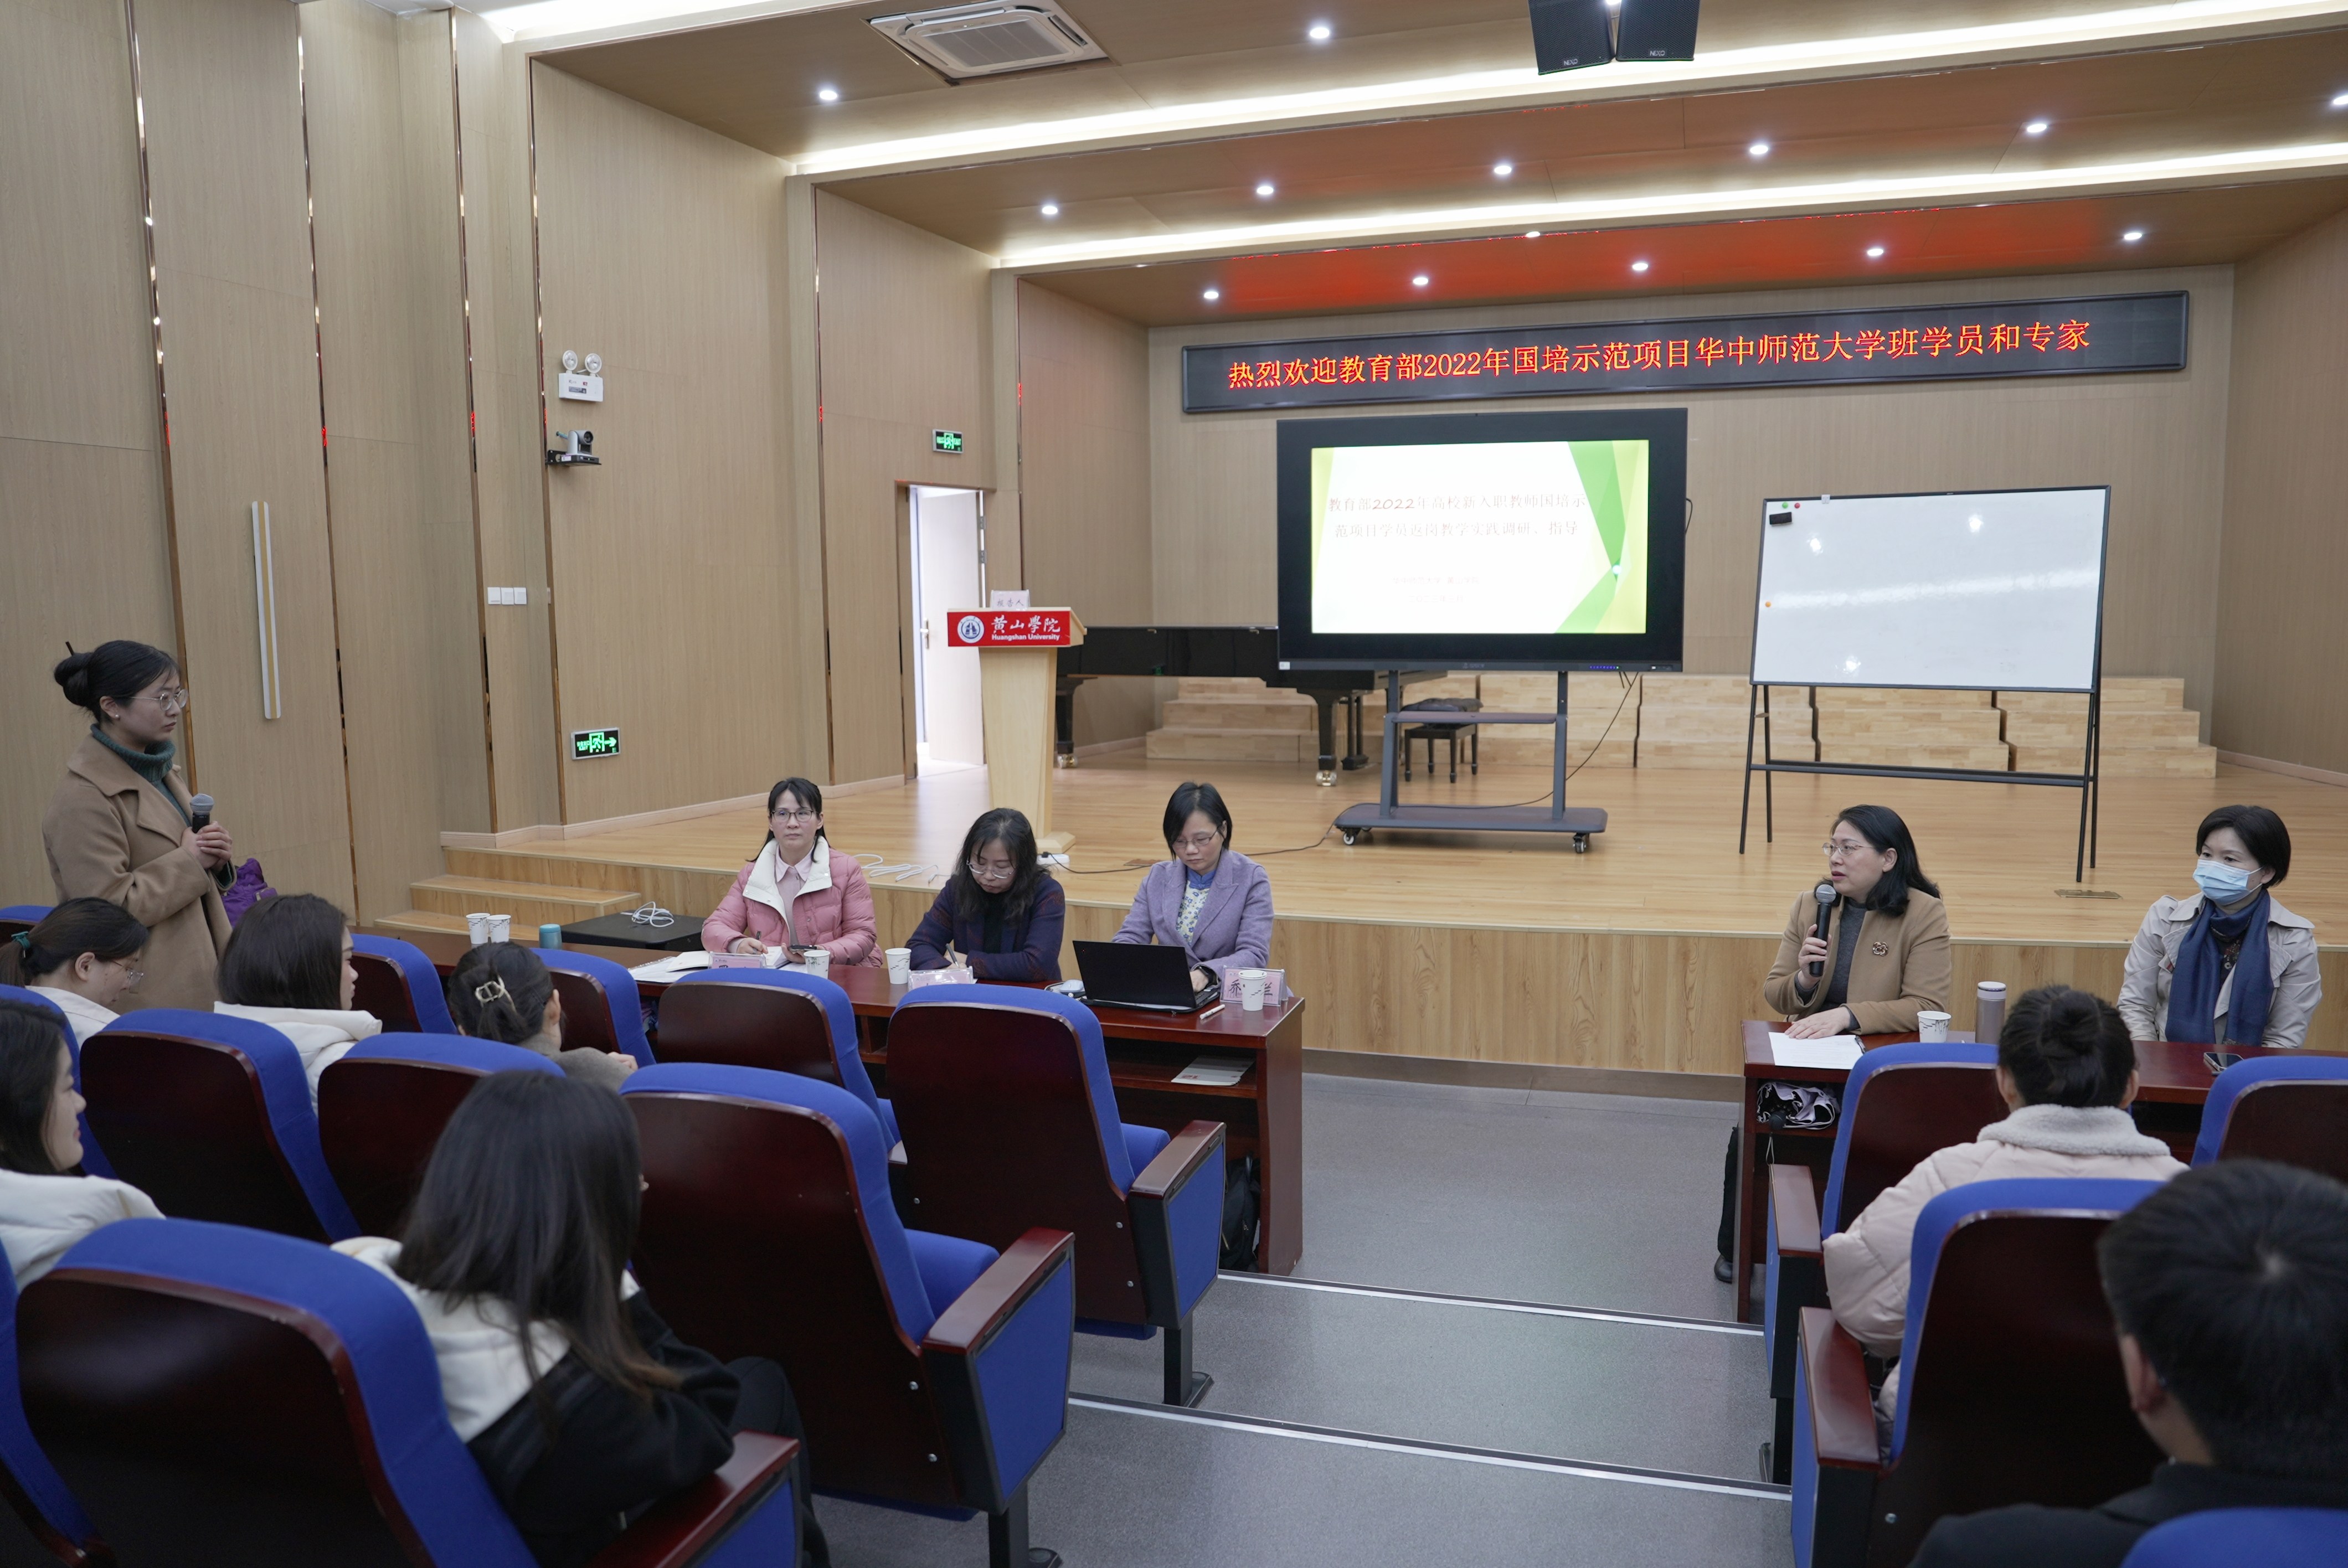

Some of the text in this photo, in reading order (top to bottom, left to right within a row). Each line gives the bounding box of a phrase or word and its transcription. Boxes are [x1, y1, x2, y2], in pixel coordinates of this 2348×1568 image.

[1228, 319, 2090, 389] 热烈欢迎教育部2022年国培示范项目华中师范大学班学员和专家
[1328, 493, 1587, 512] 教育部2022年高校新入职教师国培示
